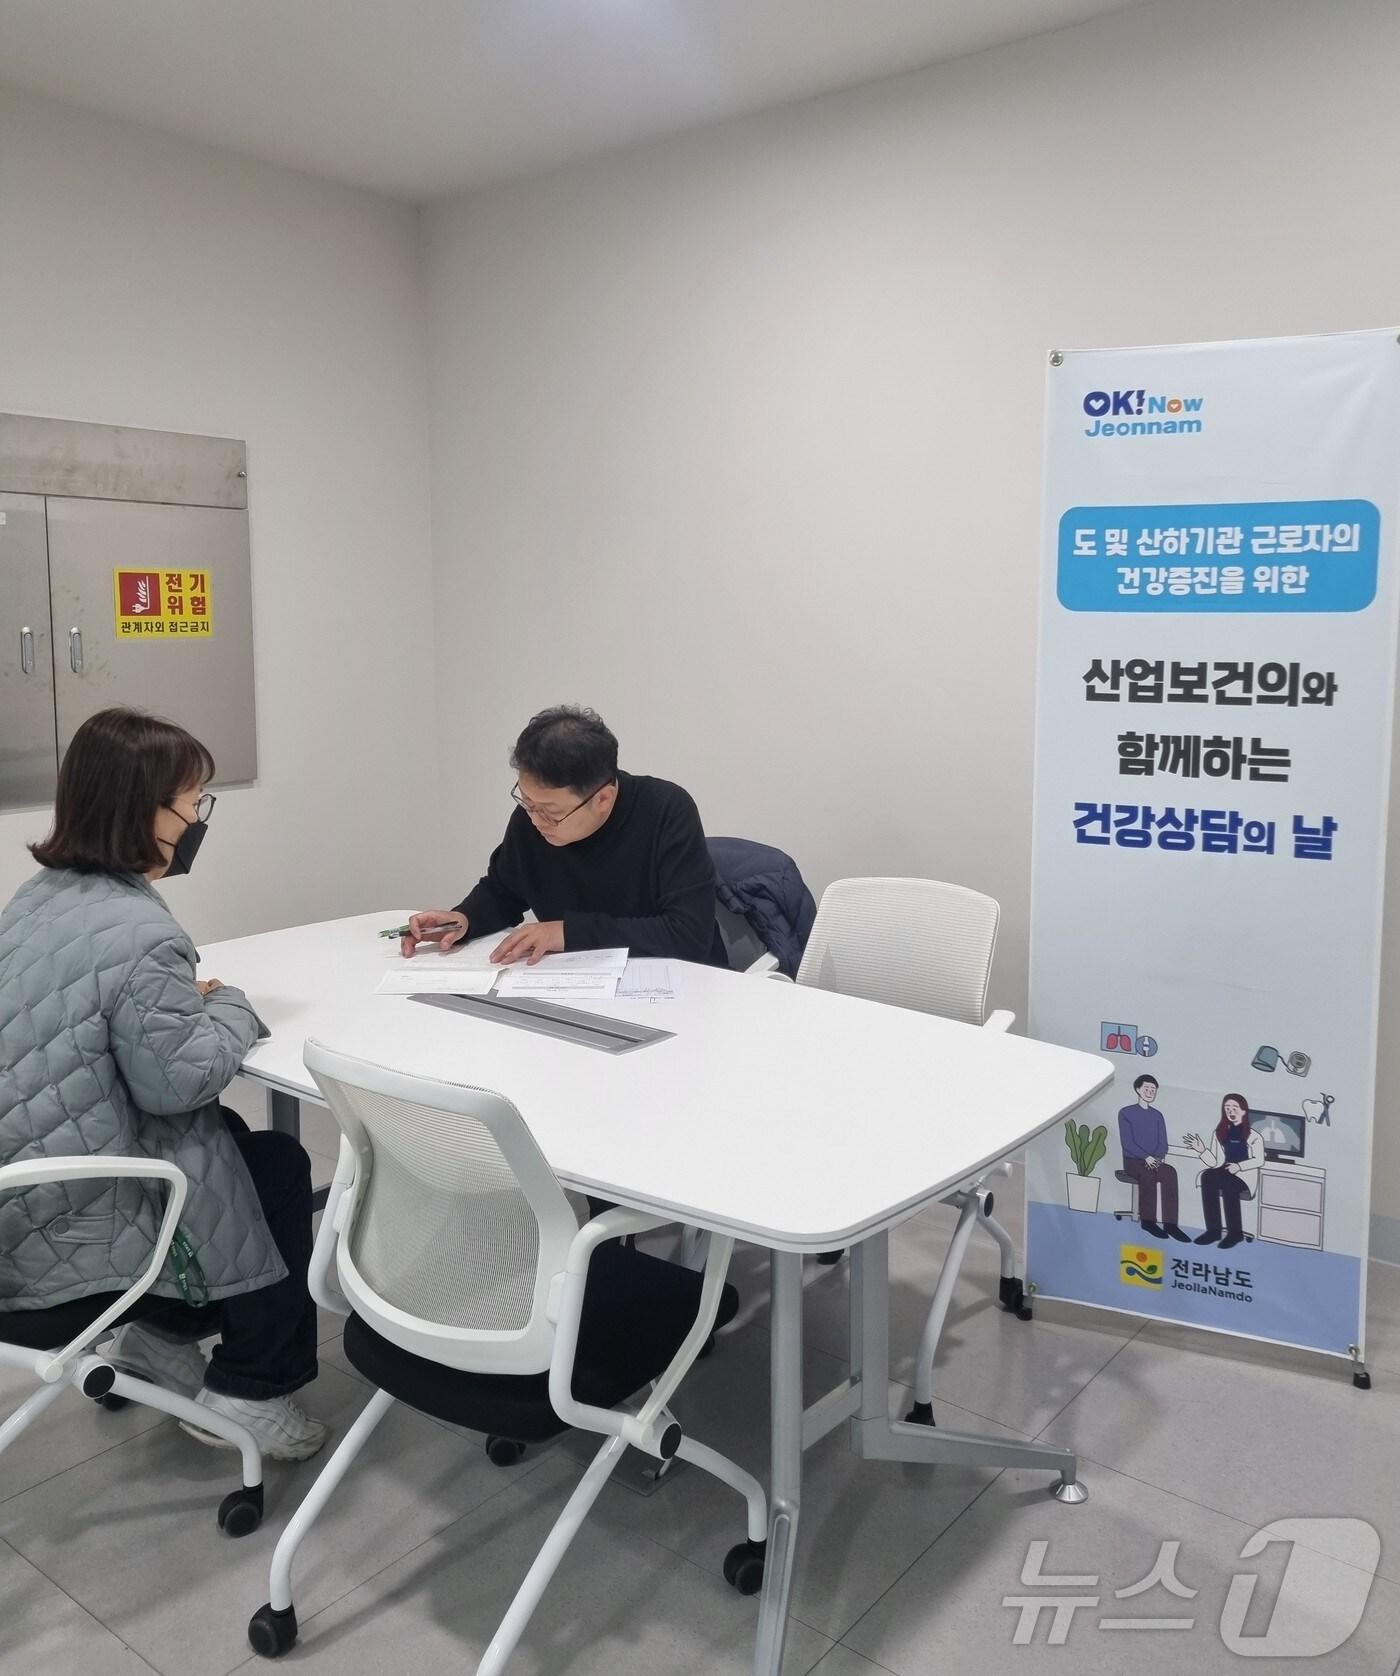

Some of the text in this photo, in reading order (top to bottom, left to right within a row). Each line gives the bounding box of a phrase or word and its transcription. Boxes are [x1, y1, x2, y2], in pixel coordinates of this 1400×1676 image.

[1083, 389, 1203, 417] OK! Now
[1084, 419, 1202, 437] Jeonnam
[1073, 524, 1360, 556] 도 및 산하기관 근로자의
[1117, 565, 1309, 596] 건강증진을 위한
[121, 621, 209, 633] 관계자외 접근금지
[1082, 658, 1338, 707] 산업보건의와
[1117, 731, 1291, 782] 함께하는
[1072, 802, 1338, 860] 건강상담의 날
[1170, 1258, 1253, 1288] 전라남도
[1171, 1280, 1253, 1303] JeollaNamdo
